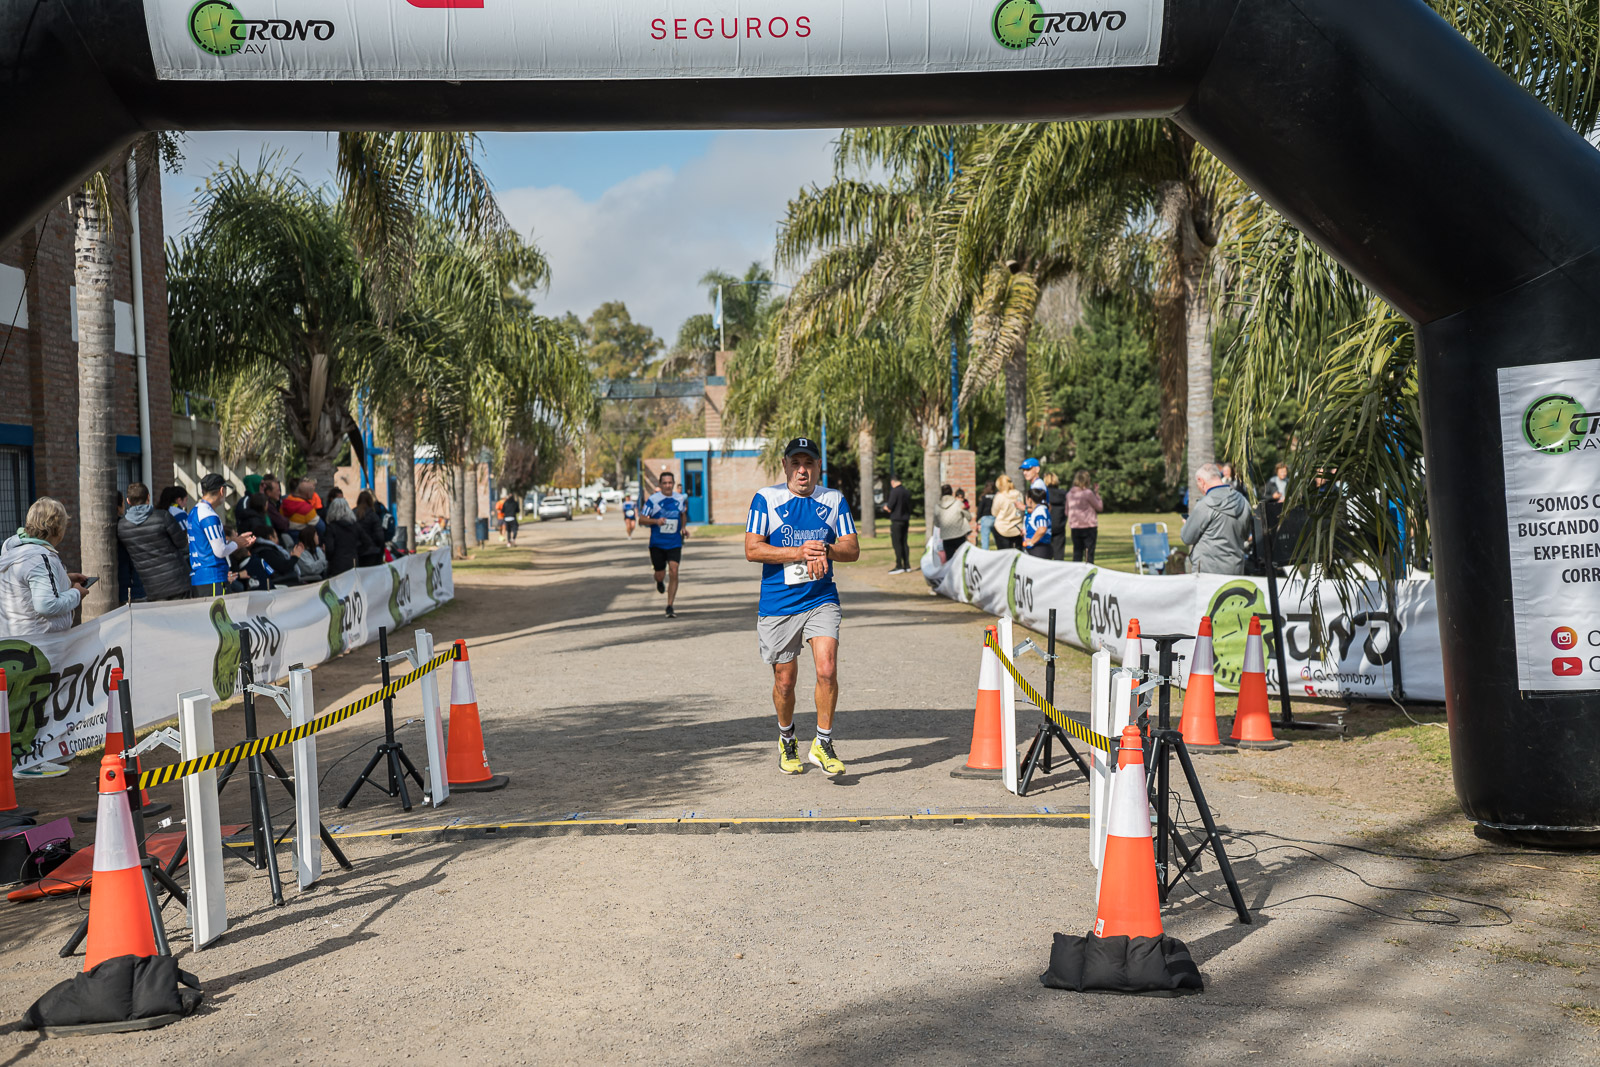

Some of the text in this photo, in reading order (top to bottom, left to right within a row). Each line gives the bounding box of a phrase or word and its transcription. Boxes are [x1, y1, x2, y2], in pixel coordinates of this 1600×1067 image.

[230, 19, 335, 41] CRONO
[650, 16, 811, 40] SEGUROS
[1028, 10, 1127, 33] CRONO
[230, 44, 267, 54] RAV
[1026, 36, 1060, 47] RAV
[799, 438, 808, 447] D
[1517, 519, 1599, 537] BUSCANDO
